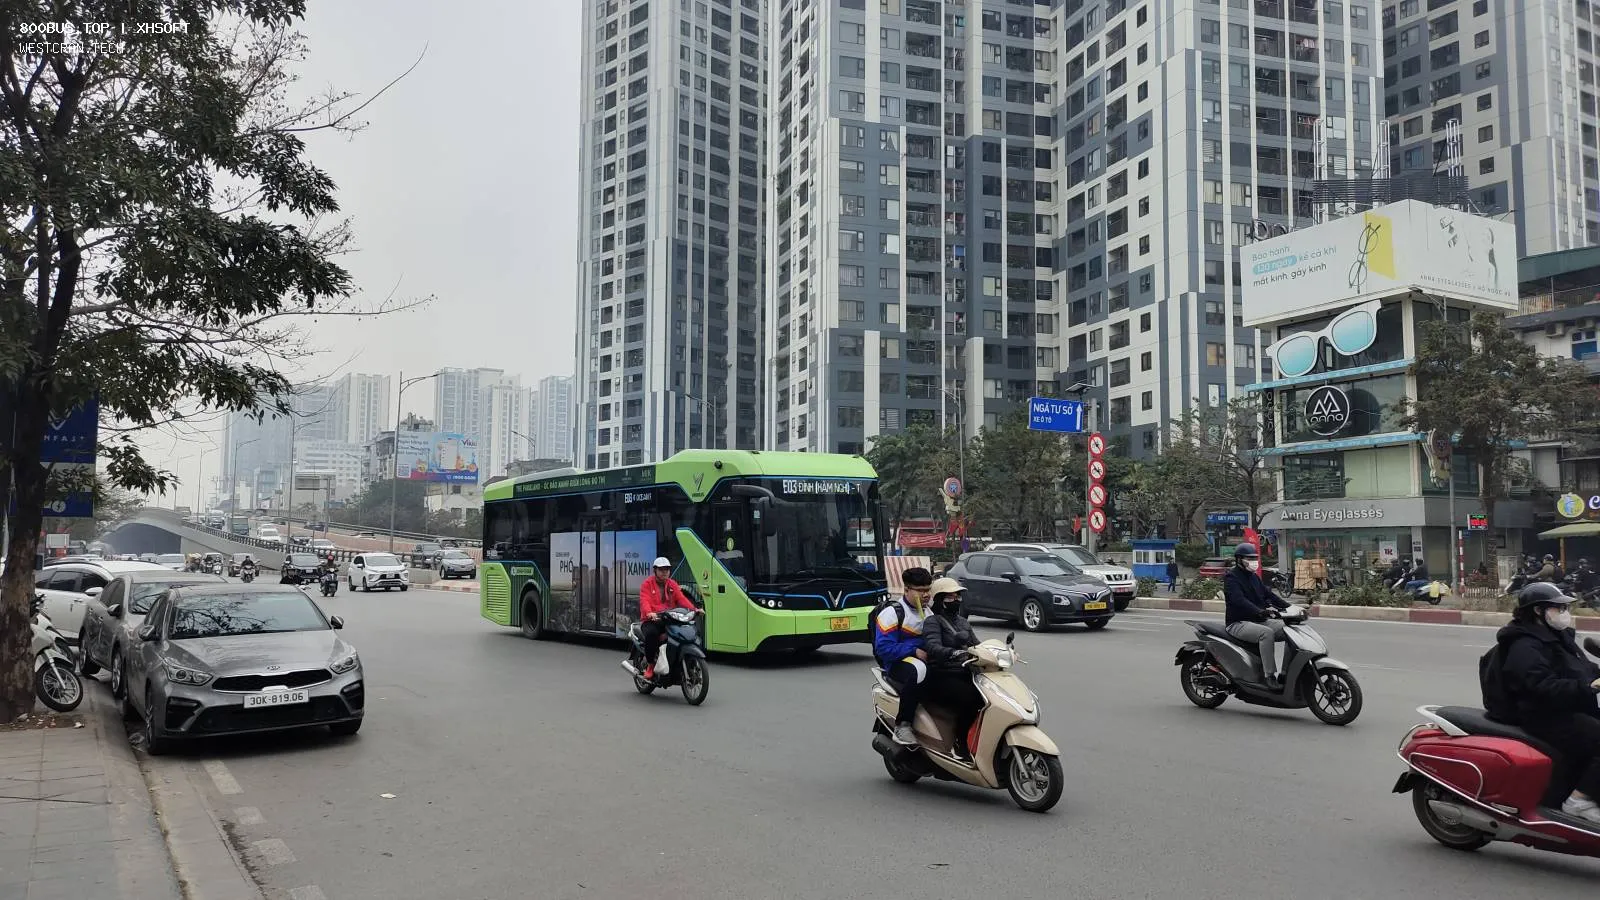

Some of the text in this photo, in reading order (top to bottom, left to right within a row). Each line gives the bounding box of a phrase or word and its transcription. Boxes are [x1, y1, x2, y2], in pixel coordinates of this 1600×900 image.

[1033, 403, 1050, 413] NGÃ
[1051, 405, 1062, 414] TƯ
[782, 479, 797, 494] E03
[798, 480, 814, 493] ĐÌNH
[1281, 507, 1383, 522] Anna Eyeglasses
[627, 561, 651, 576] XANH
[249, 692, 304, 706] 30K-819.06
